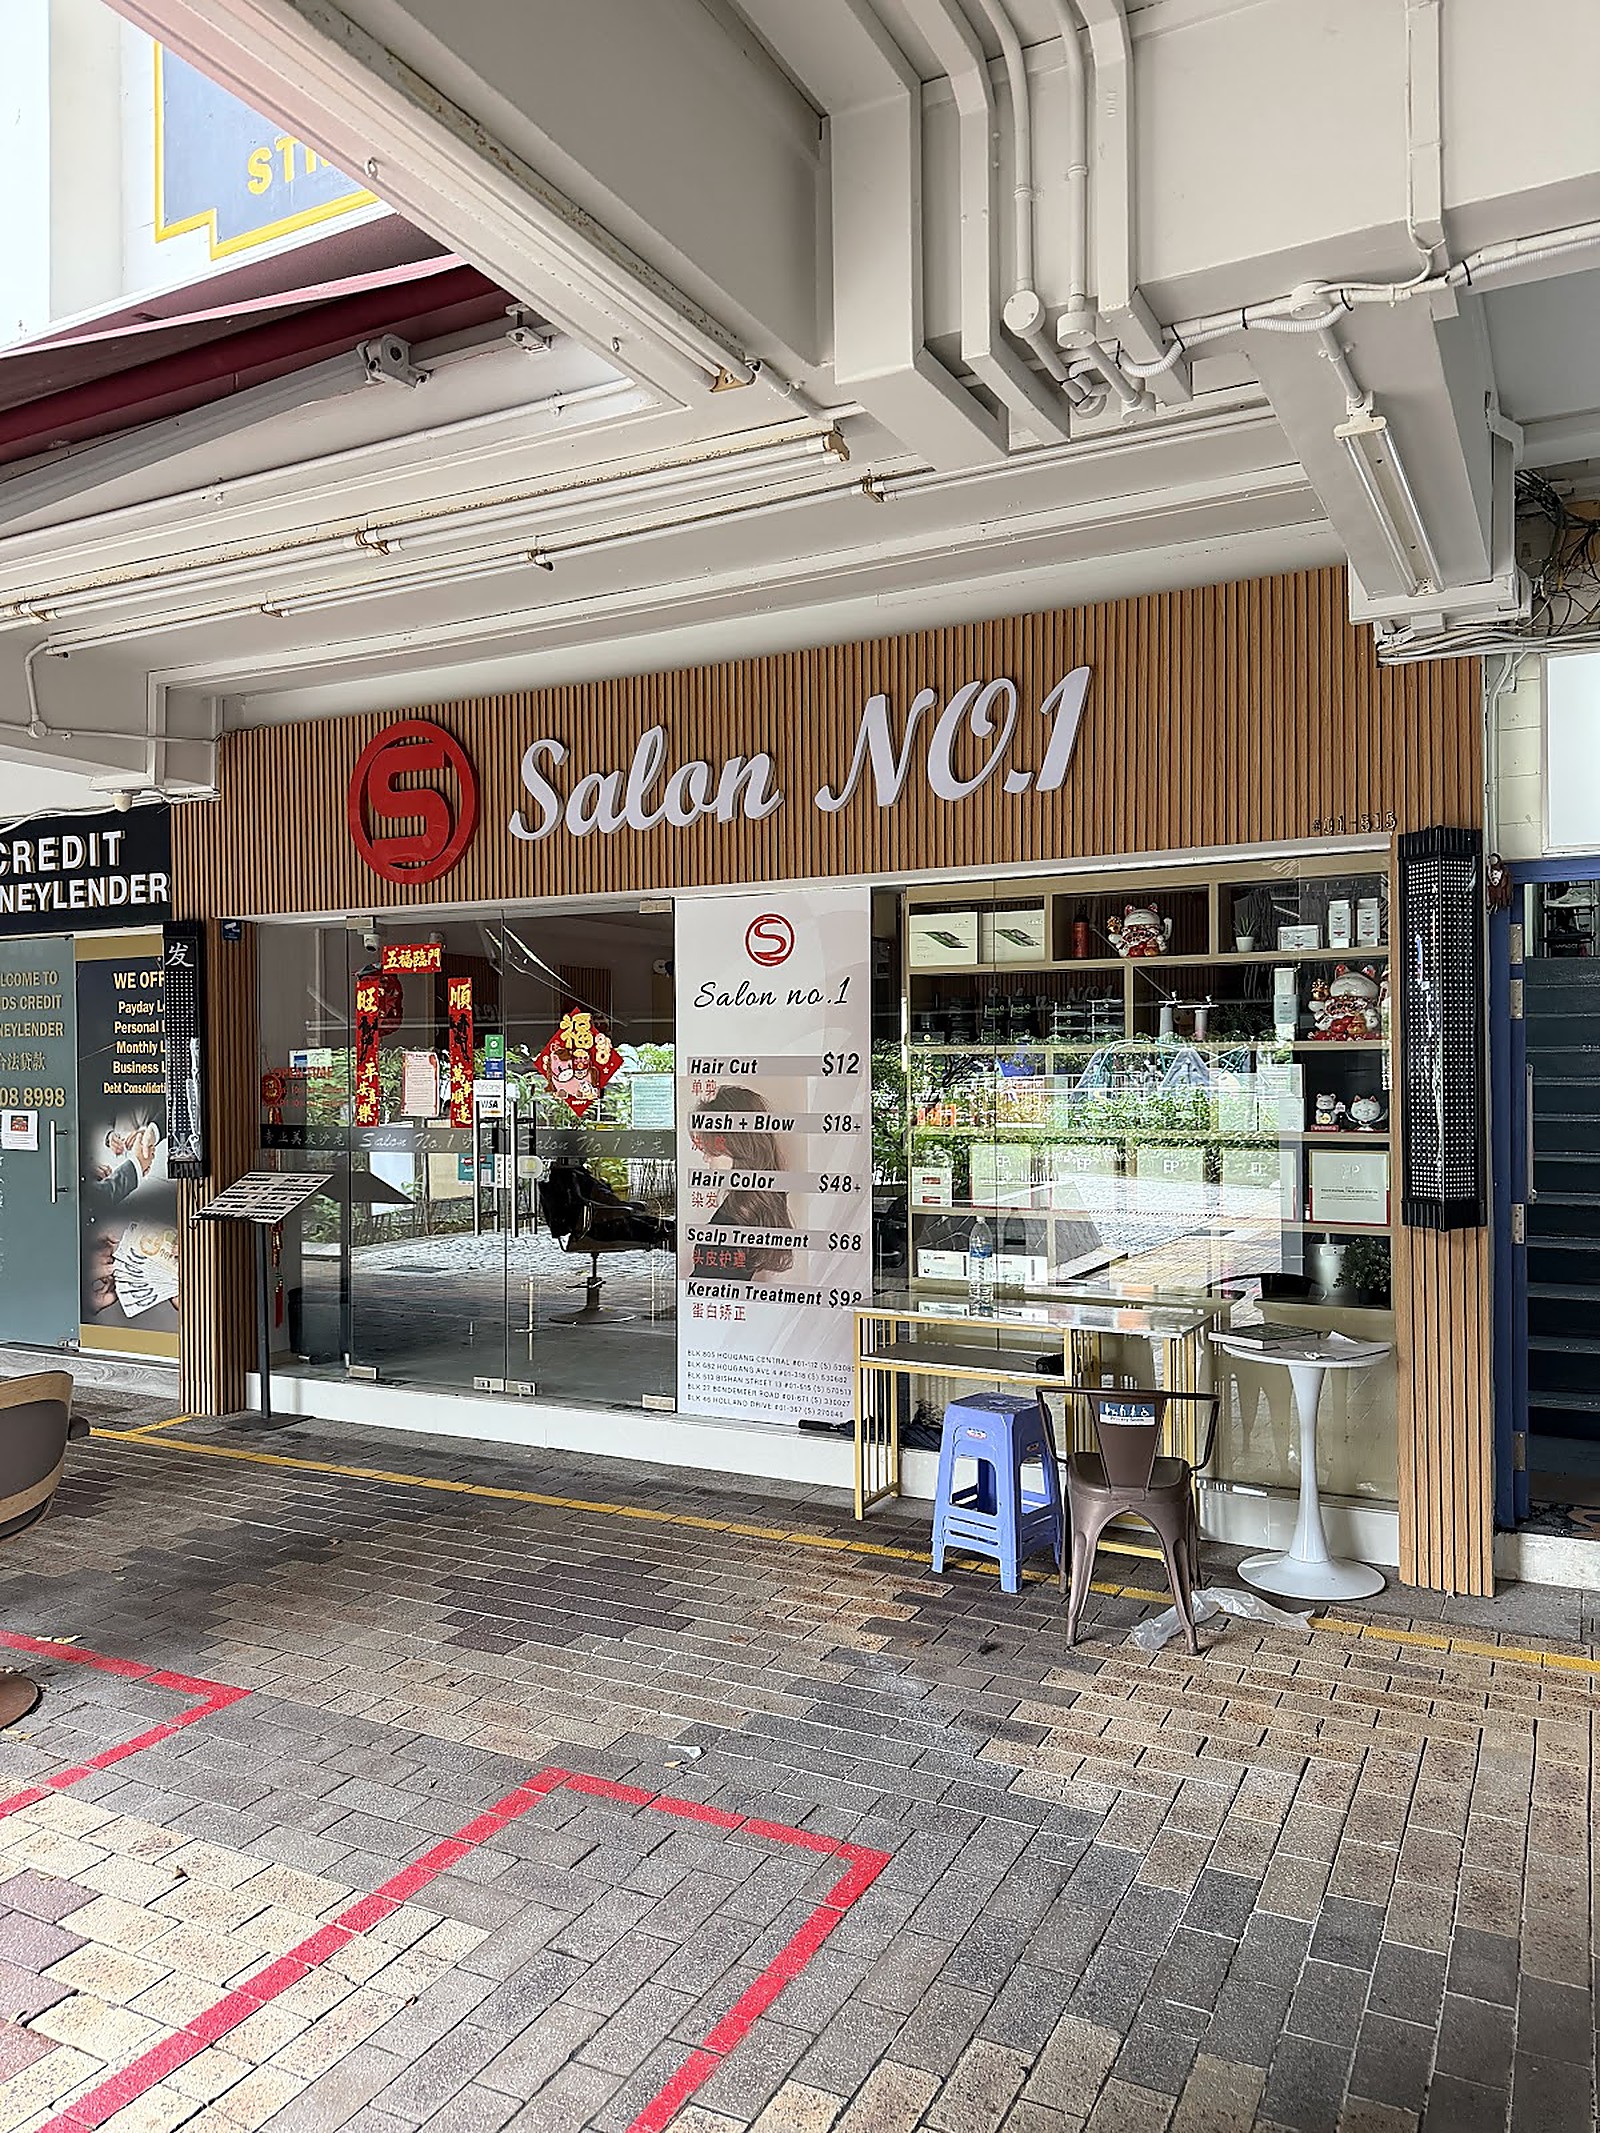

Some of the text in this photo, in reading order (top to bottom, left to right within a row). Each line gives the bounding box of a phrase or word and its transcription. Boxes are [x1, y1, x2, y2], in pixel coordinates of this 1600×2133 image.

[508, 665, 1092, 842] Salon NO.1
[165, 942, 194, 967] 发
[383, 947, 441, 969] 五福臨門
[43, 970, 58, 985] TO
[113, 972, 137, 990] WE
[20, 995, 62, 1010] CREDIT
[356, 986, 379, 1013] 旺
[450, 982, 473, 1011] 順
[694, 980, 777, 1008] Salon
[118, 1000, 155, 1016] Payday
[114, 1020, 159, 1034] Personal
[560, 1013, 594, 1050] 福
[116, 1041, 161, 1056] Monthly
[113, 1061, 159, 1074] Business
[691, 1052, 860, 1076] Hair Cut $12
[104, 1082, 122, 1093] Debt
[23, 1087, 65, 1107] 8998
[480, 1100, 498, 1109] VISA
[691, 1114, 733, 1130] Wash
[738, 1118, 748, 1126] +
[754, 1115, 795, 1131] Blow
[358, 1132, 406, 1148] Salon
[518, 1134, 569, 1151] Salon
[691, 1171, 724, 1187] Hair
[730, 1173, 775, 1189] Color
[692, 1191, 719, 1208] 染发
[687, 1228, 863, 1251] Scalp Treatment $68
[692, 1250, 746, 1268] 头皮护理
[687, 1282, 740, 1299] Keratin
[745, 1285, 822, 1305] Treatment
[692, 1302, 747, 1321] 蛋白矫正
